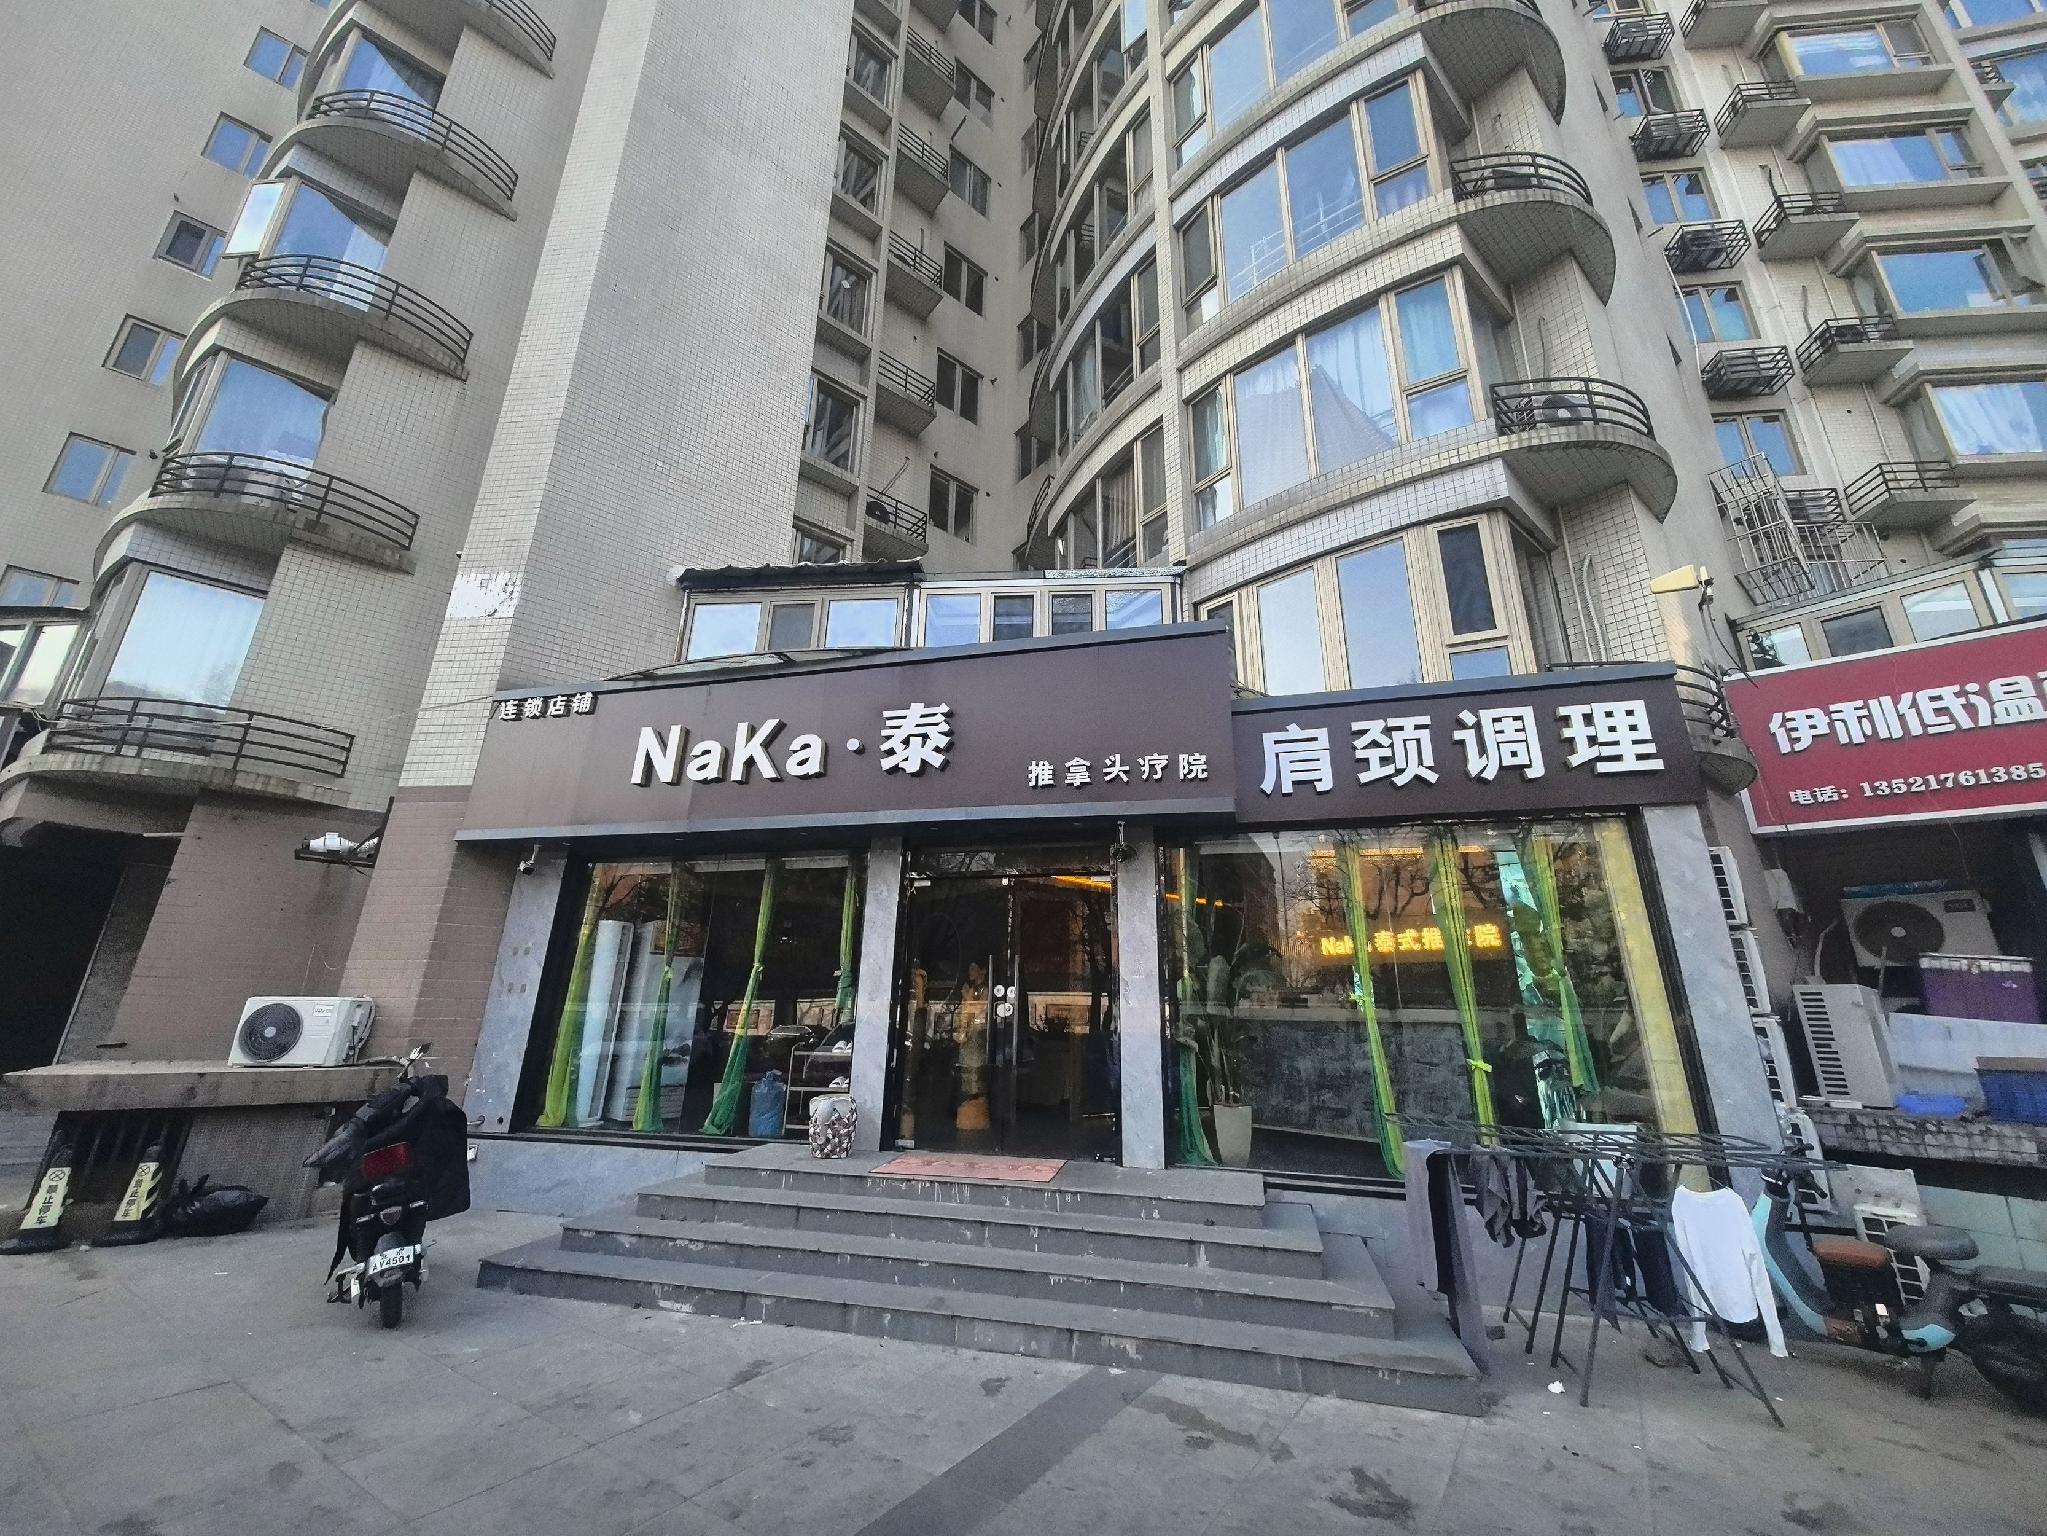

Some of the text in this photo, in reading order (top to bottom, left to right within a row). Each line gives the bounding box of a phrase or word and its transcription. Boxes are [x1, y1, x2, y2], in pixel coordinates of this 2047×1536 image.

[499, 692, 594, 719] 连锁店铺
[1768, 671, 2047, 755] 伊利低温
[1260, 700, 1666, 797] 肩颈调理
[1028, 753, 1209, 787] 推拿头疗院
[1860, 762, 2047, 797] 13521761385
